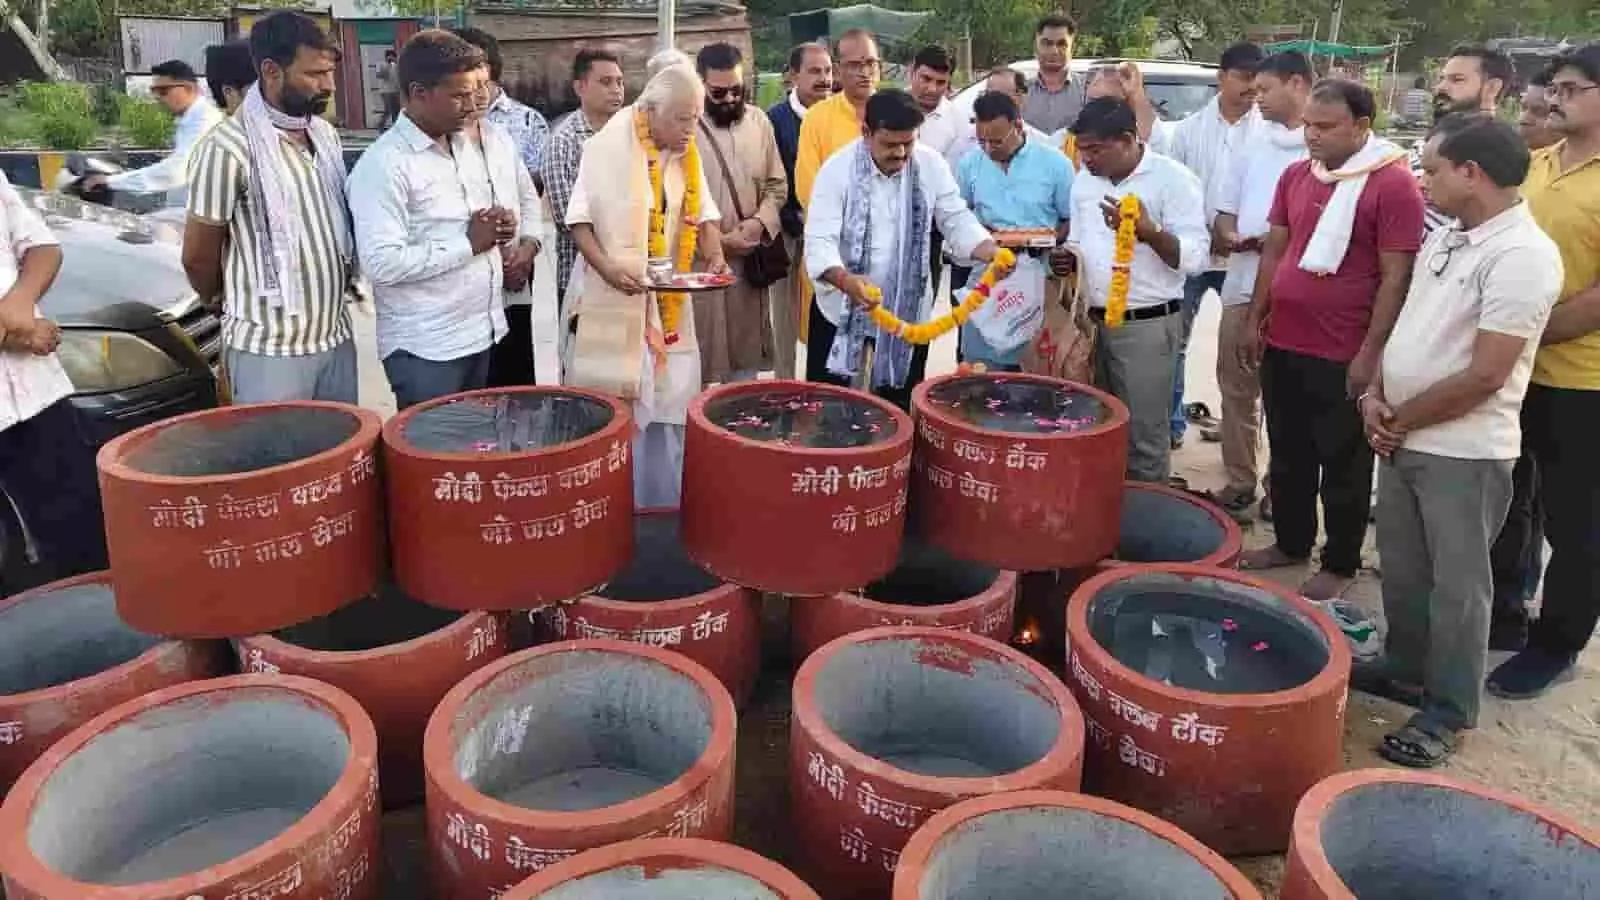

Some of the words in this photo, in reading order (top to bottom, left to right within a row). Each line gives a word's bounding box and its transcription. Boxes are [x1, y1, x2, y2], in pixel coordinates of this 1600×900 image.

[432, 471, 487, 504] मोदी
[791, 465, 843, 495] मोदी
[145, 495, 208, 529] मोदी
[808, 751, 849, 801] मोदी
[447, 812, 493, 861] मोदी
